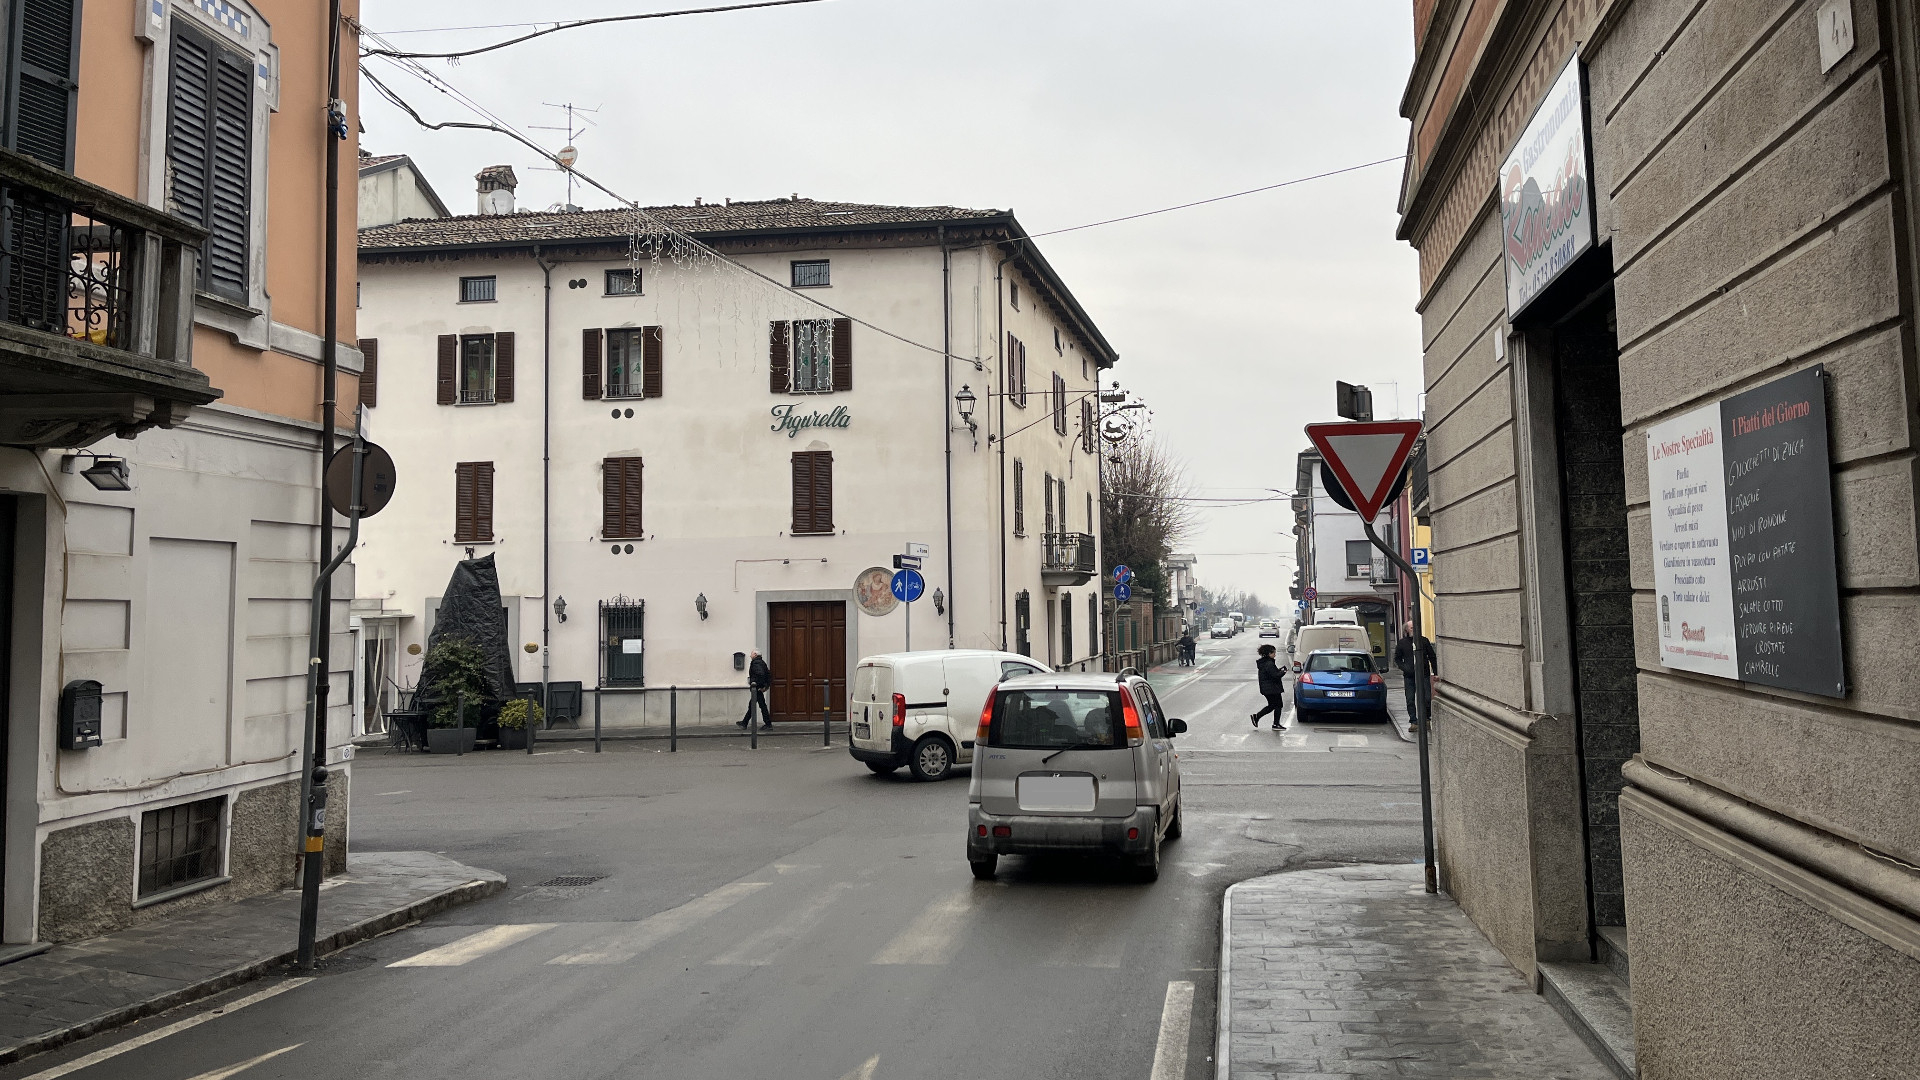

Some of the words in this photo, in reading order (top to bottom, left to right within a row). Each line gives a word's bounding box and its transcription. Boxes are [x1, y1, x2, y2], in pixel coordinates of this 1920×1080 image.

[1523, 78, 1578, 174] Gastronomia
[770, 402, 851, 438] Figurella
[1732, 418, 1736, 438] I
[1738, 410, 1760, 435] Piatti
[1762, 406, 1775, 428] del
[1776, 400, 1810, 424] Giorno
[1652, 446, 1660, 460] Le
[1661, 441, 1680, 458] Nostre
[1681, 426, 1714, 455] Specialità
[1728, 447, 1770, 486] GNOCCHETTI
[1772, 446, 1780, 462] DI
[1782, 438, 1804, 461] ZUCCA
[1687, 502, 1691, 513] di
[1692, 503, 1703, 516] pesce
[1731, 488, 1760, 514] LASAGNE
[1674, 521, 1687, 533] Arrosti
[1689, 520, 1698, 531] misti
[1732, 524, 1746, 542] NIDI
[1750, 520, 1756, 535] DI
[1758, 509, 1787, 533] RONDINE
[1678, 541, 1690, 552] vapore
[1692, 538, 1696, 549] in
[1414, 550, 1425, 563] P
[1686, 557, 1690, 567] in
[1734, 553, 1756, 573] POLPO
[1758, 549, 1771, 563] CON
[1773, 541, 1796, 560] PATATE
[1674, 574, 1694, 584] Prosciutto
[1695, 576, 1705, 584] cotto
[1738, 576, 1767, 595] ARROSTI
[1699, 591, 1710, 602] dolci
[1739, 600, 1761, 618] SALAME
[1763, 600, 1784, 612] COTTO
[1740, 621, 1766, 638] VERDURE
[1770, 622, 1793, 635] RIPIENE
[1755, 640, 1786, 655] CROSTATE
[1745, 660, 1779, 677] CIAMBELLE
